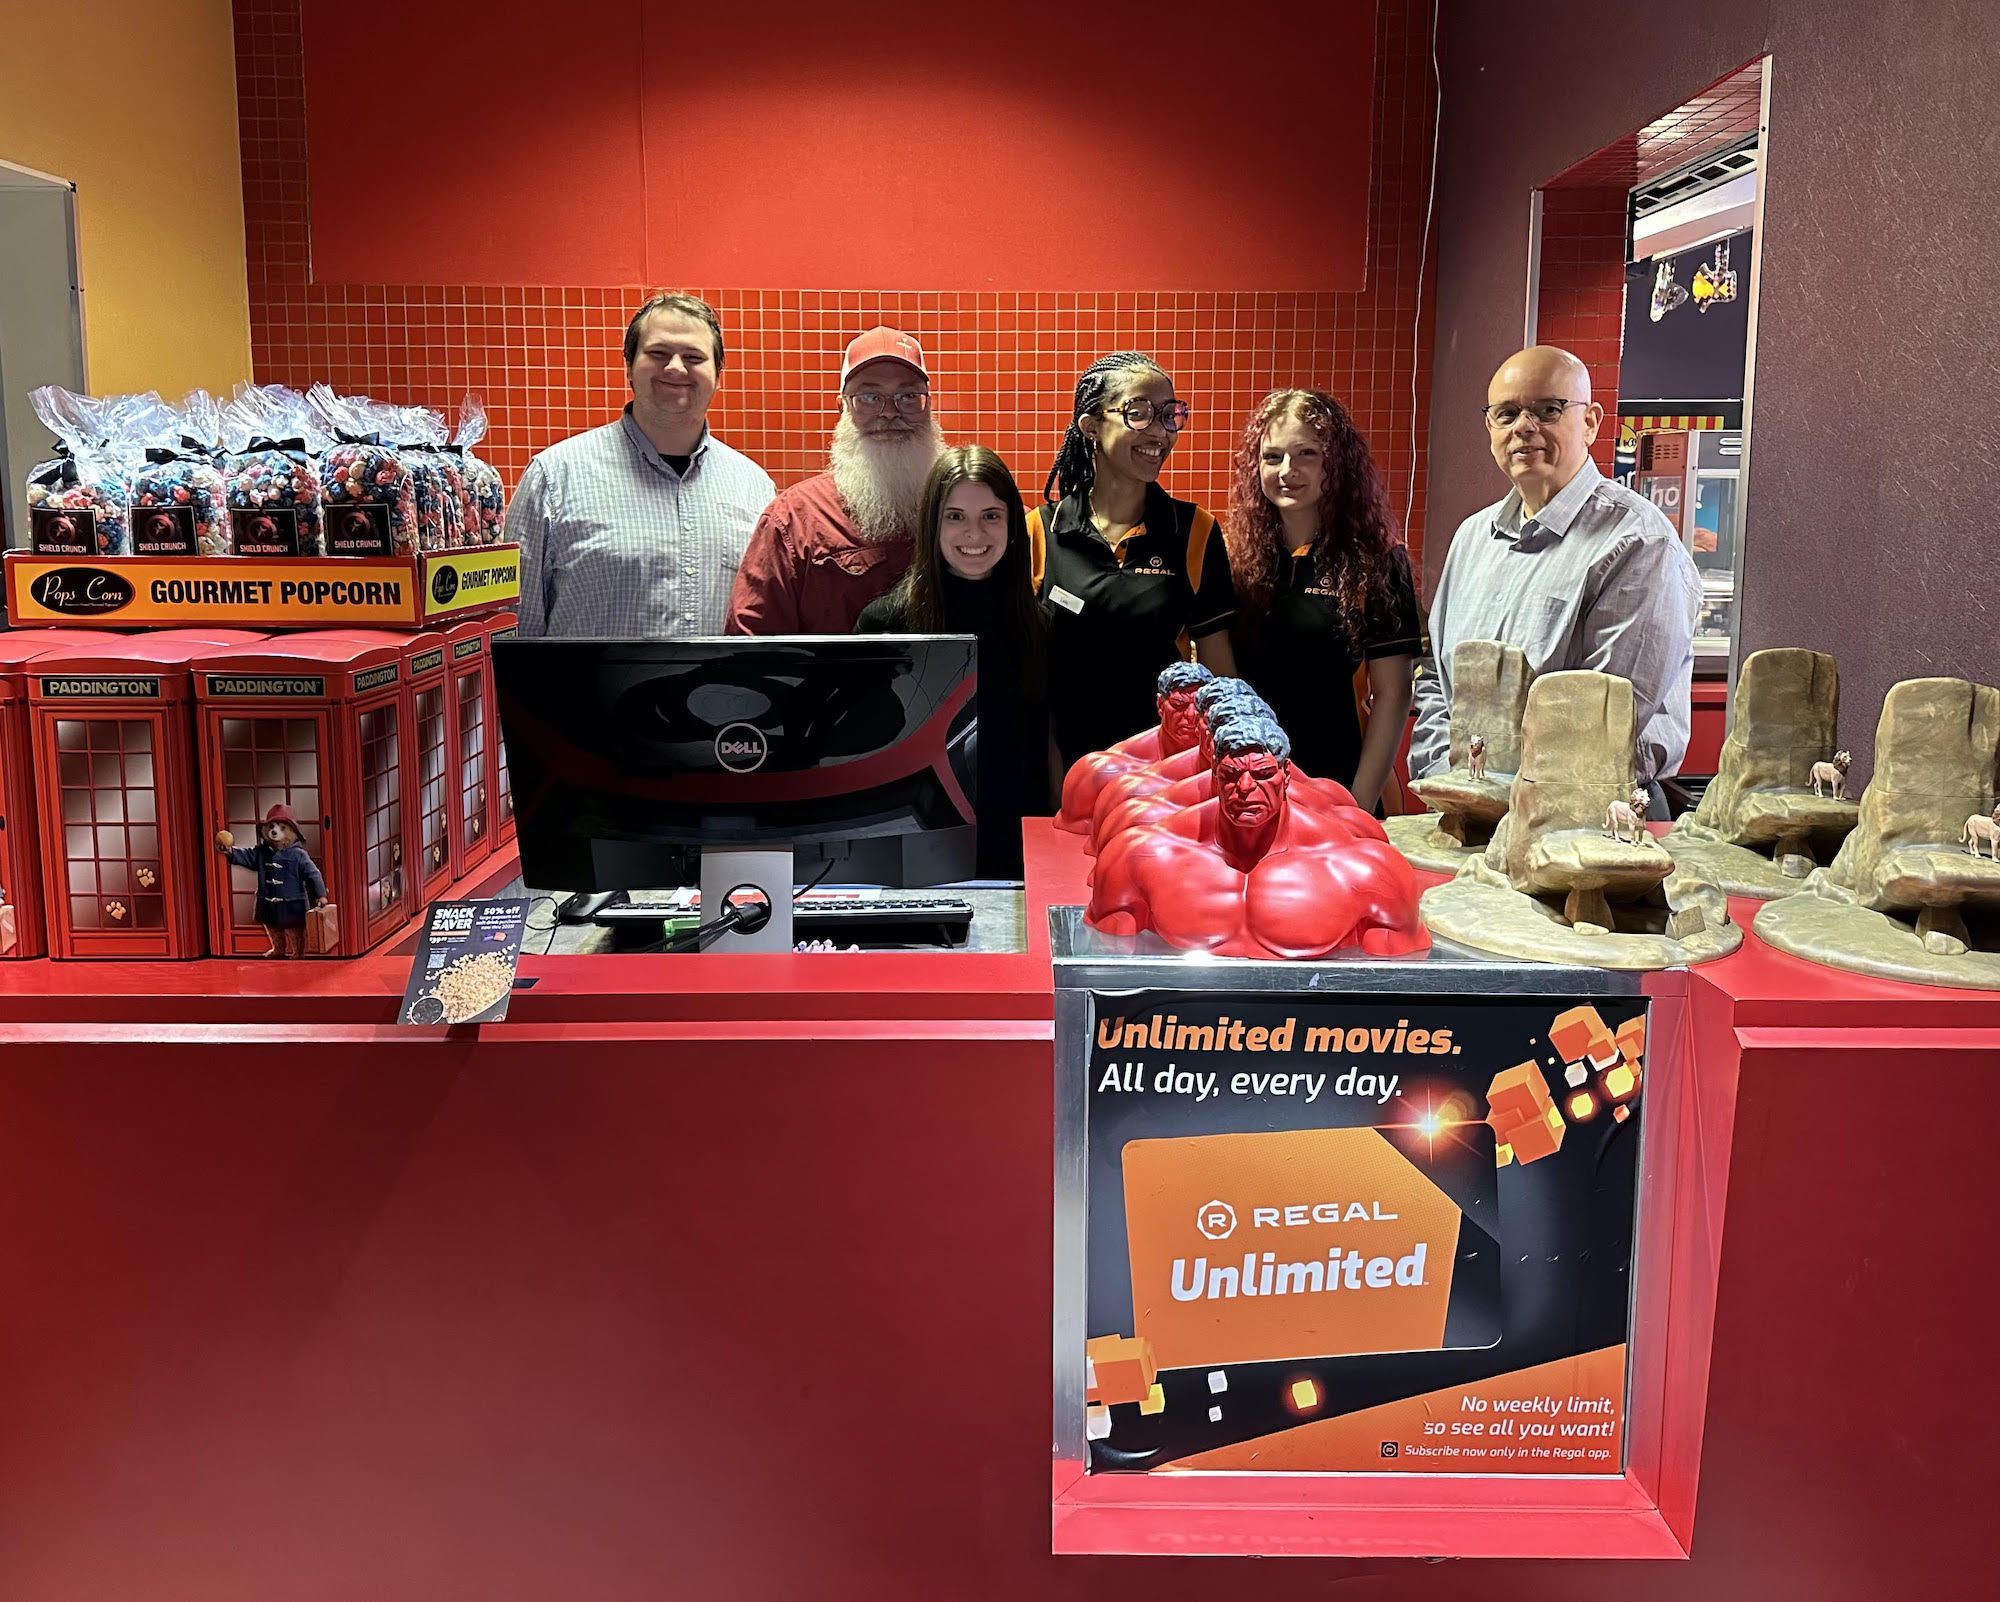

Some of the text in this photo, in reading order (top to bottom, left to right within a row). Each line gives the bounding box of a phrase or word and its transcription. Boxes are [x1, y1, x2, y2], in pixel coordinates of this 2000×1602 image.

[39, 543, 87, 553] SHIELD CRUNCH
[139, 542, 187, 551] SHIELD CRUNCH
[240, 544, 289, 553] SHIELD CRUNCH
[334, 540, 382, 548] SHIELD CRUNCH
[461, 565, 517, 591] GOURMET POPCORN
[1134, 567, 1175, 576] REGAL
[42, 575, 124, 606] Pops Corn
[150, 579, 402, 605] GOURMET POPCORN
[721, 741, 762, 754] DELL
[435, 906, 477, 920] SNACK
[483, 906, 521, 915] 50% off
[431, 919, 473, 931] SAVER
[1097, 1014, 1462, 1055] Unlimited movies.
[1097, 1062, 1402, 1105] All day, every day.
[1253, 1200, 1398, 1228] REGAL
[1170, 1242, 1428, 1301] Unlimited
[1460, 1395, 1615, 1417] No weekly limit,
[1423, 1419, 1615, 1440] so see all you want!
[1404, 1445, 1612, 1461] Subscribe now only in the Regal app.
